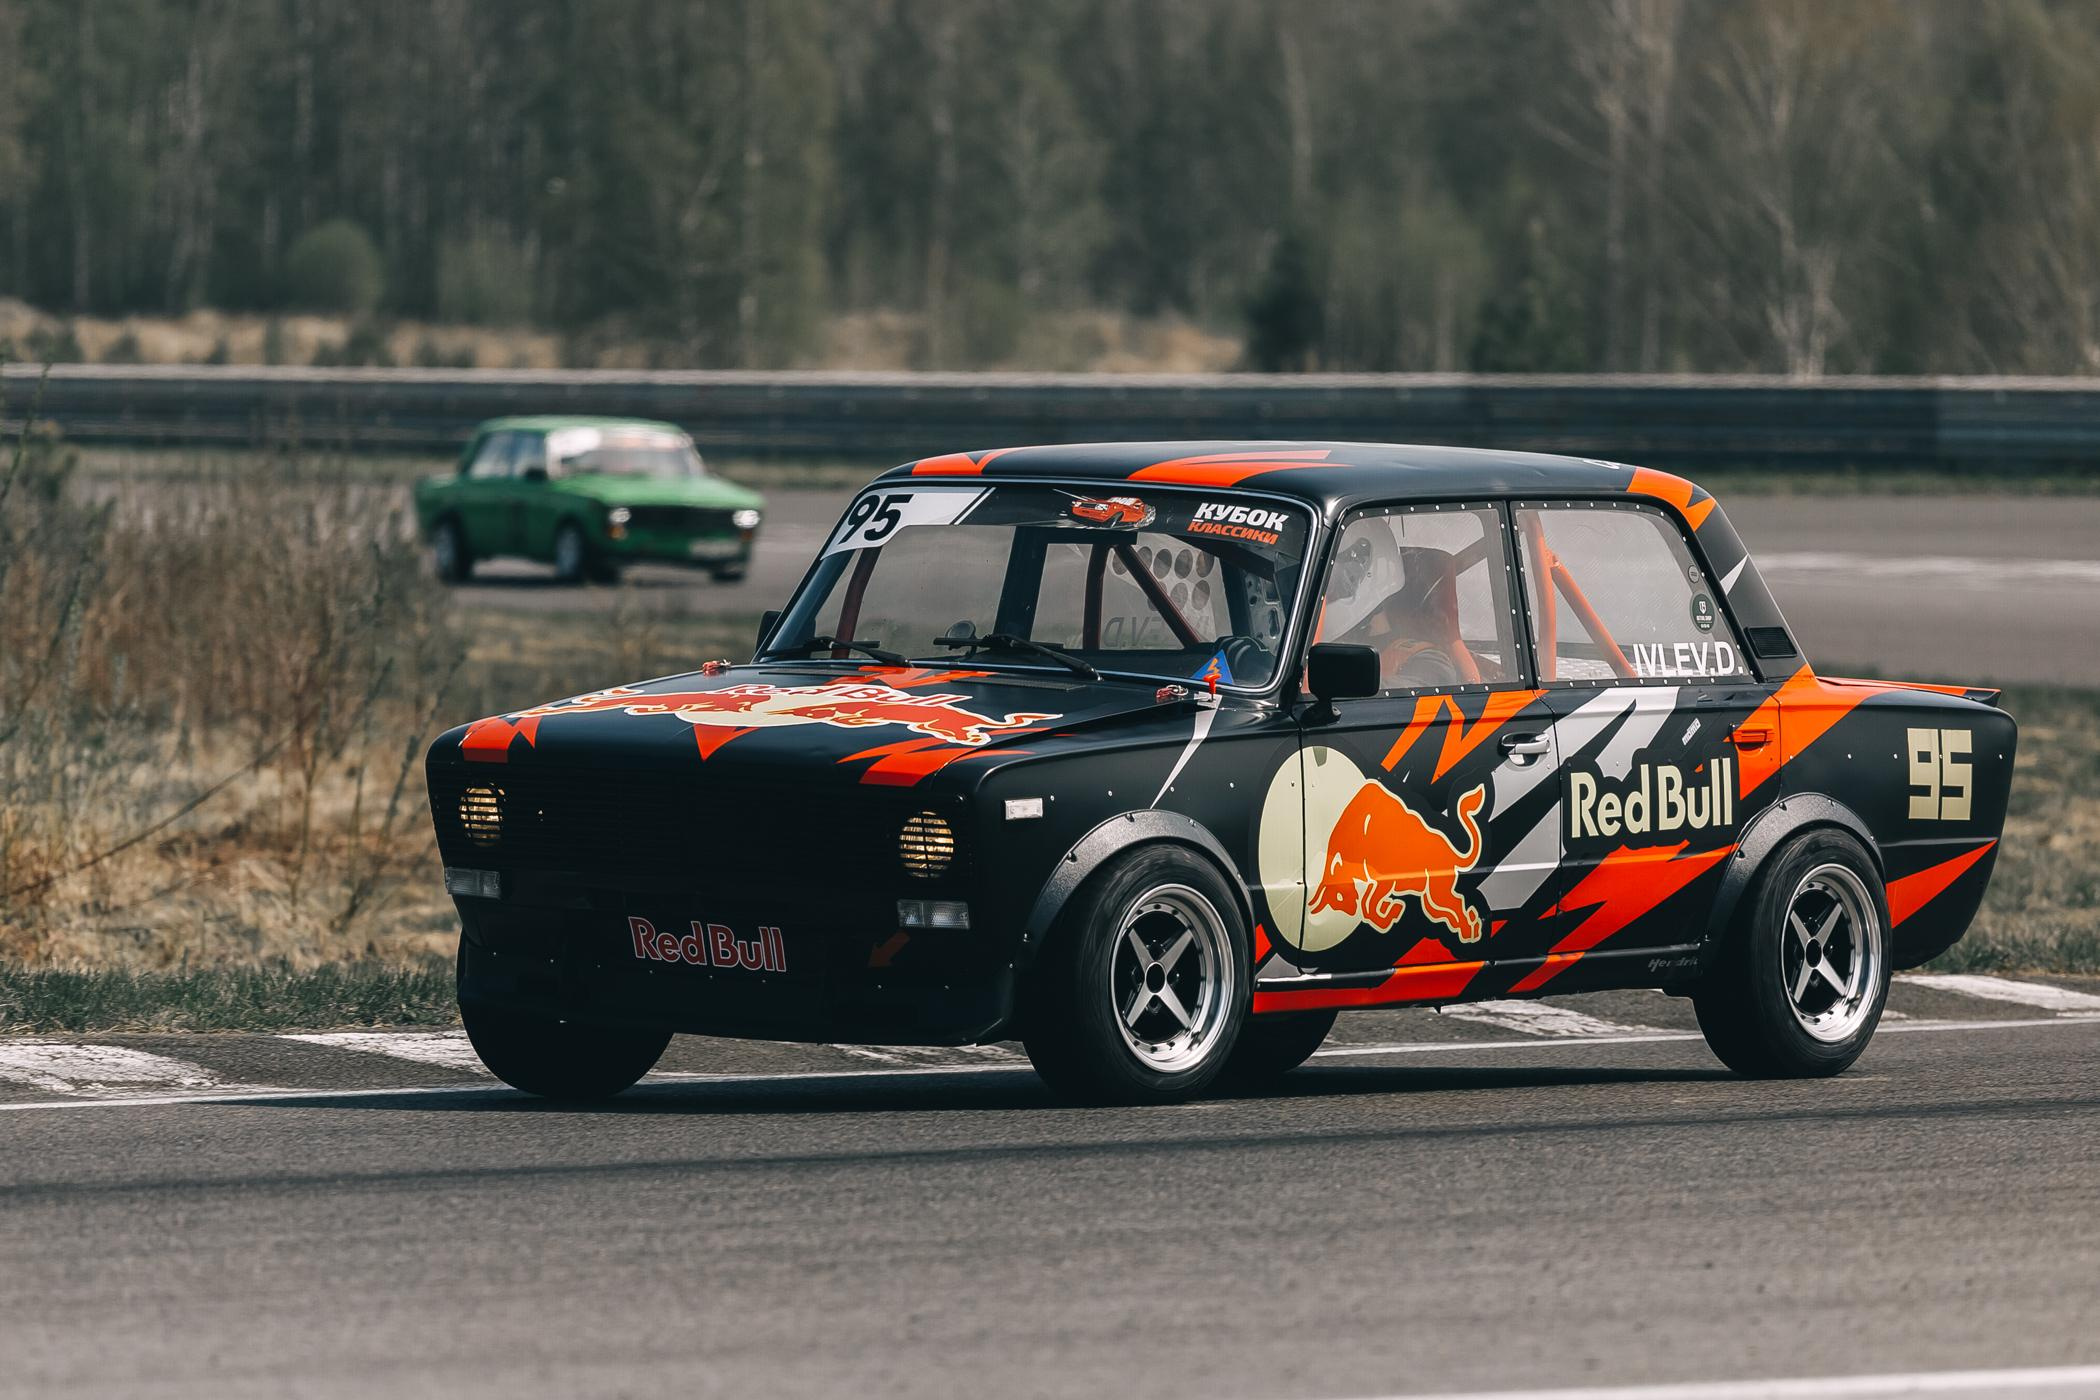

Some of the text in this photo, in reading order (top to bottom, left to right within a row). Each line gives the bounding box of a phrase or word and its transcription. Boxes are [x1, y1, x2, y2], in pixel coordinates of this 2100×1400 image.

[838, 494, 914, 545] 95
[1187, 521, 1279, 545] КЛАССИКИ
[1192, 502, 1290, 532] КУБОК
[708, 684, 972, 709] Red Bull
[1570, 757, 1733, 838] Red Bull
[1907, 727, 1973, 821] 95
[628, 916, 787, 972] Red Bull
